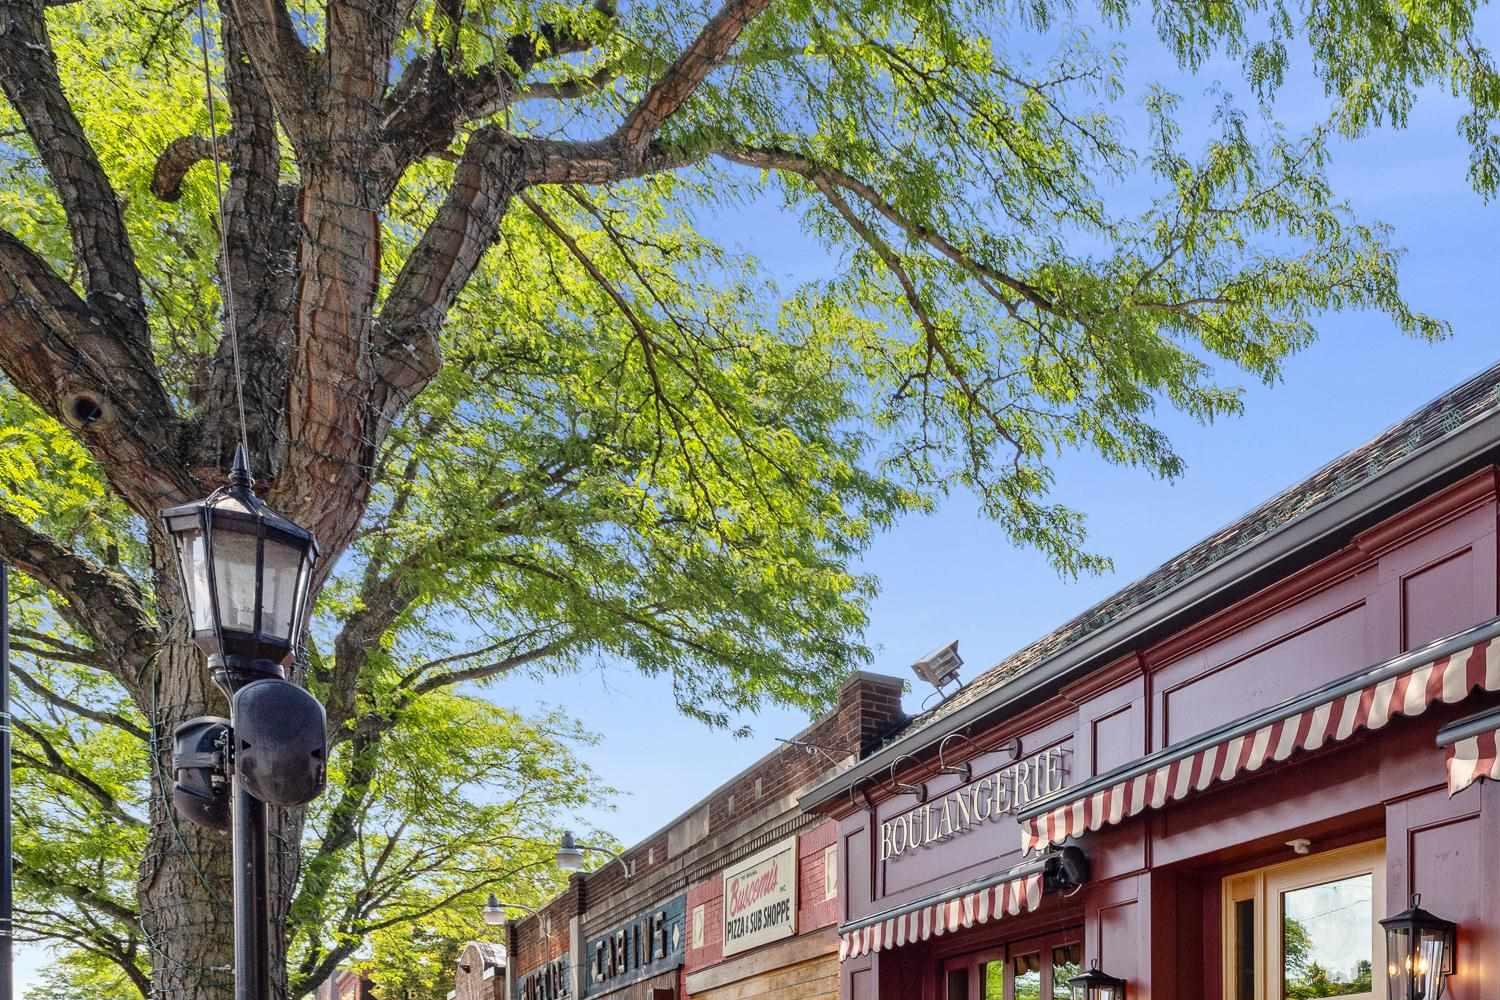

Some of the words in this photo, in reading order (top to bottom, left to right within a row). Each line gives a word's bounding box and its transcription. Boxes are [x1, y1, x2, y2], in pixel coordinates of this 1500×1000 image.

[880, 744, 1064, 861] BOULANGERIE
[595, 911, 666, 983] CABINS
[727, 917, 745, 941] PIZZA
[750, 910, 763, 934] SUB
[763, 898, 790, 929] SHOPPE
